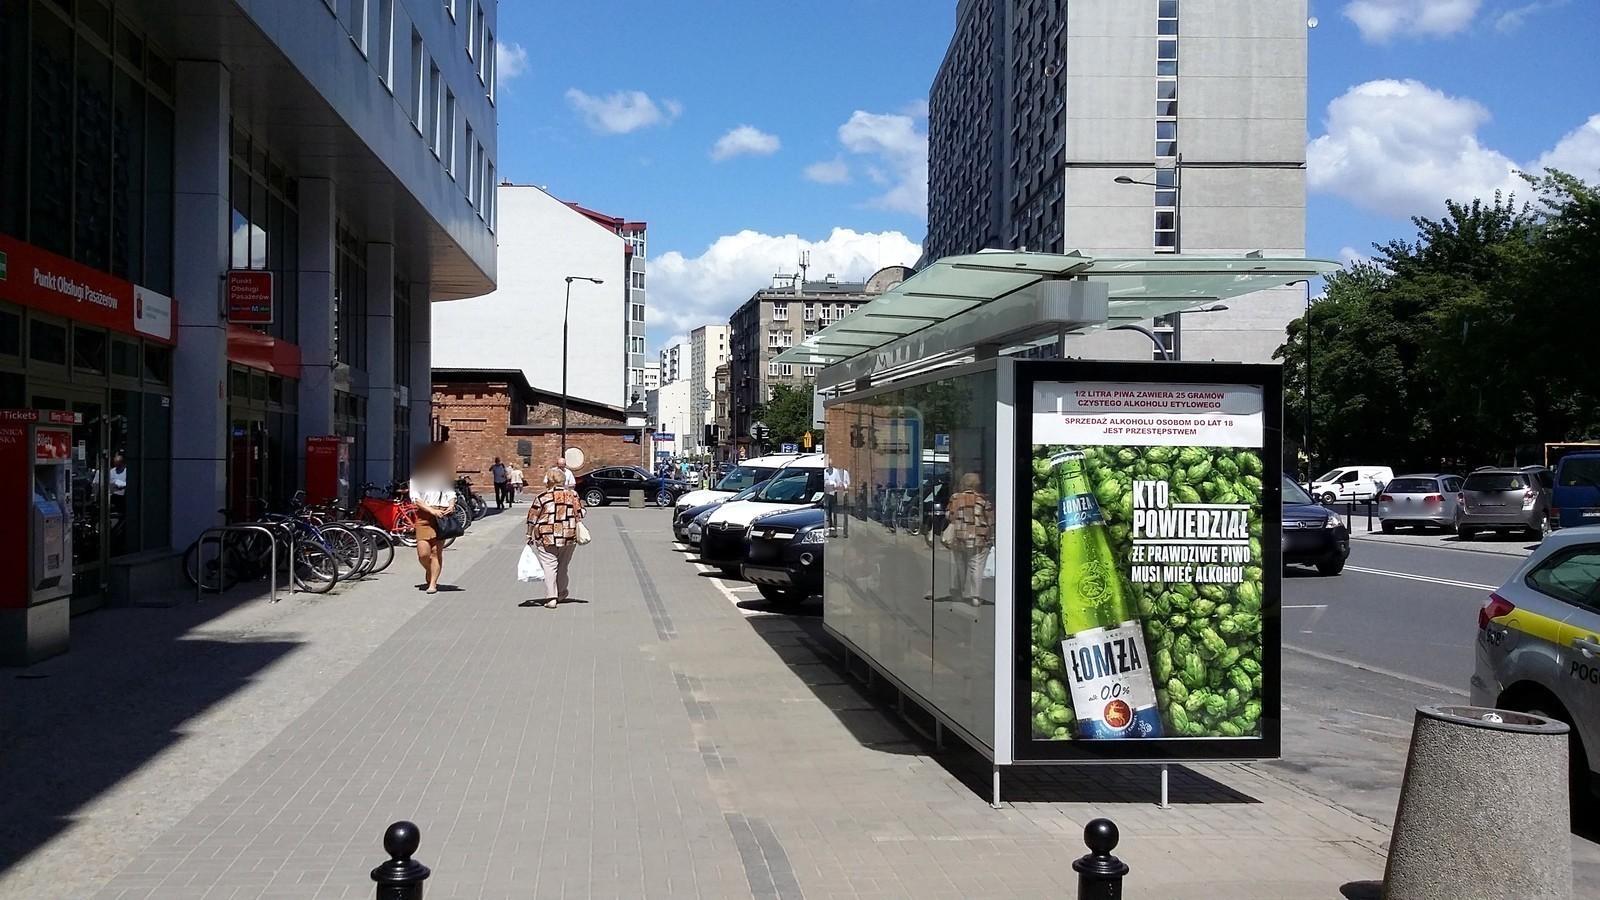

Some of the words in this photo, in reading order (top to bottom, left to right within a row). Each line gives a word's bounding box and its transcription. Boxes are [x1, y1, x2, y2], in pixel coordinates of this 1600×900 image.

[33, 267, 57, 291] Punkt
[1074, 390, 1086, 398] 1/2
[1087, 390, 1111, 399] LITRA
[1113, 391, 1135, 399] PIWA
[1136, 391, 1174, 400] ZAWIERA
[1175, 391, 1187, 399] 25
[1077, 399, 1122, 408] CZYSTEGO
[1123, 400, 1168, 408] ALKOHOLU
[1170, 401, 1222, 409] ETYLOWEGO
[4, 411, 37, 420] Tickets
[1064, 416, 1108, 425] SPRZEDAŻ
[1109, 418, 1154, 426] ALKOHOLU
[1156, 419, 1192, 427] OSOBOM
[1193, 419, 1206, 427] DO
[1207, 419, 1222, 427] LAT
[1103, 427, 1124, 435] JEST
[1132, 480, 1169, 509] KTO
[1132, 509, 1250, 539] POWIEDZIAŁ
[1148, 545, 1218, 563] PRAWDZIWE
[1220, 545, 1251, 563] PIWO
[1131, 565, 1161, 583] MUSI
[1163, 562, 1193, 583] MIEĆ
[1194, 565, 1244, 583] ALKOHOL
[1570, 661, 1600, 685] POG
